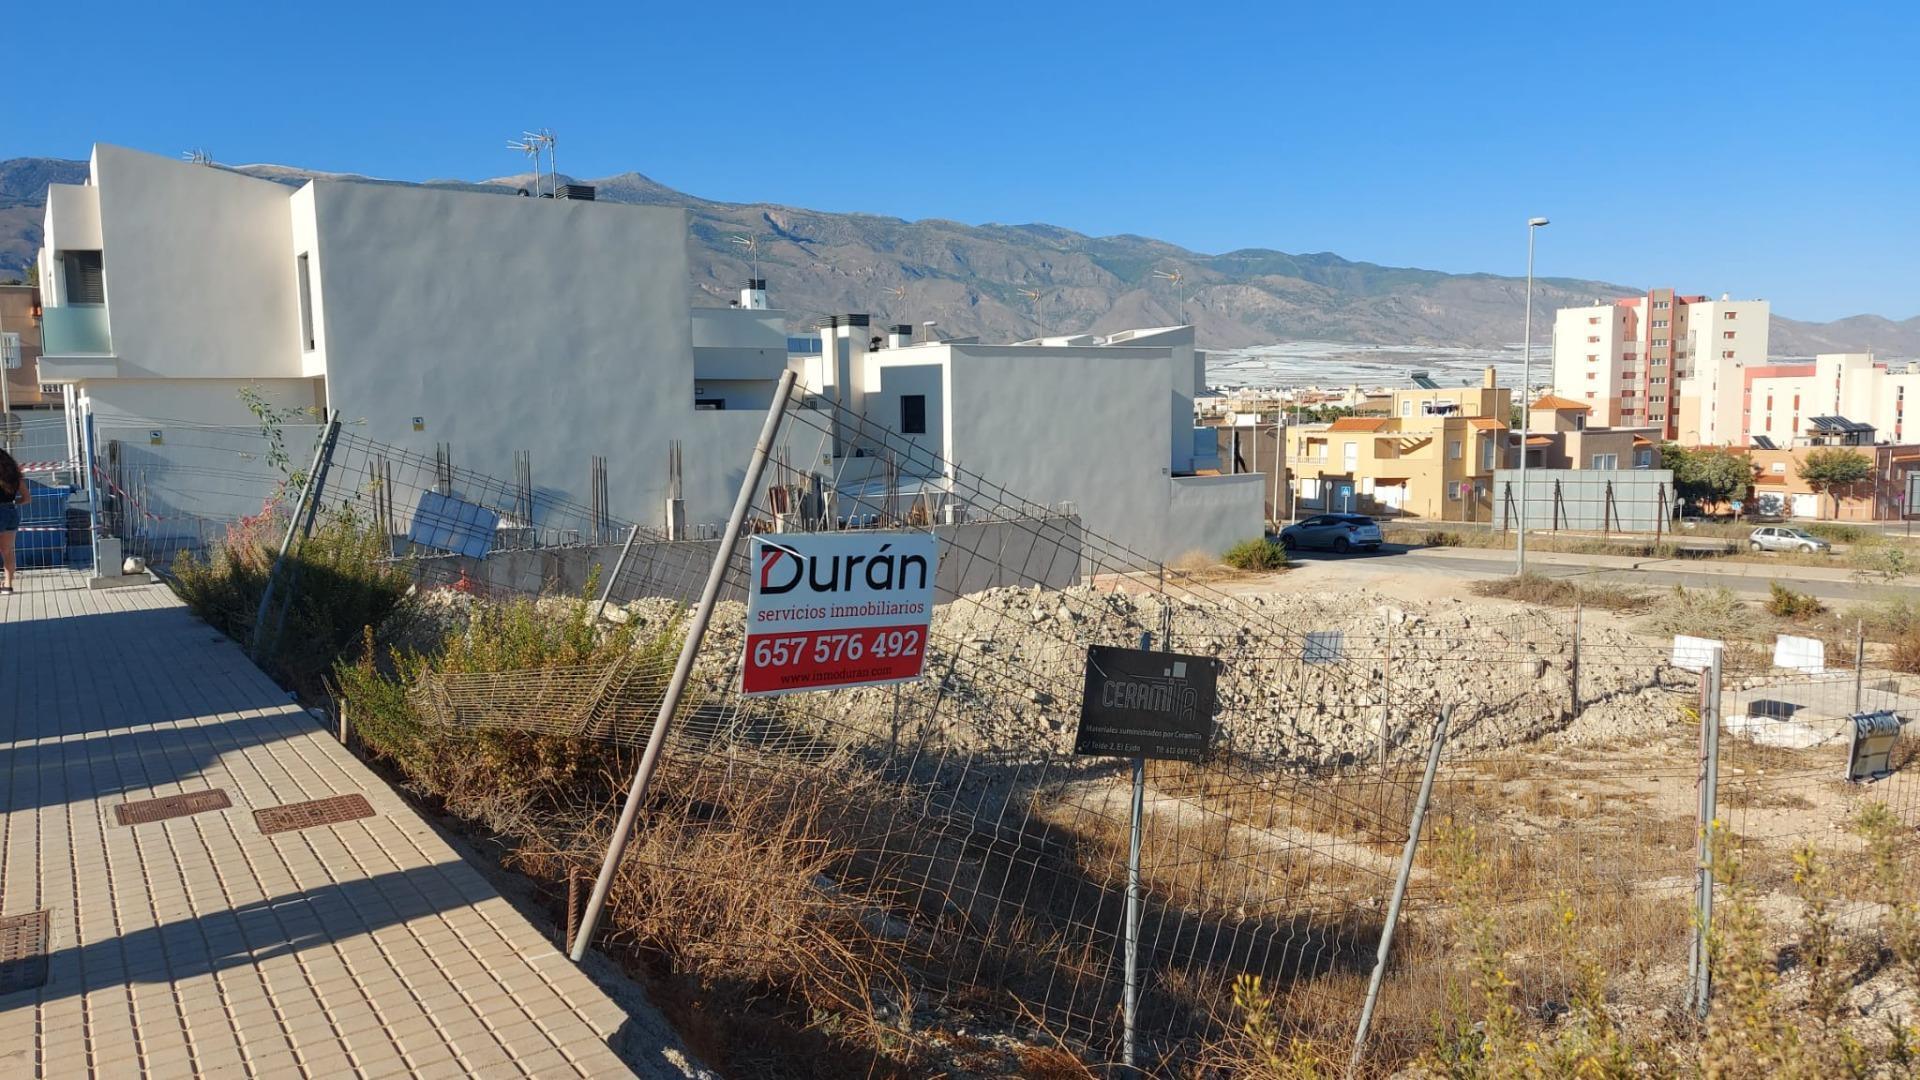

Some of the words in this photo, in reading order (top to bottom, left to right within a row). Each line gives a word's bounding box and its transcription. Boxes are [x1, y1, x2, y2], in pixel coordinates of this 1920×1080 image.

[760, 544, 927, 594] Durán
[757, 604, 826, 622] servicios
[830, 600, 924, 618] inmobiliarios
[754, 637, 808, 668] 657
[814, 633, 863, 663] 576
[871, 630, 919, 658] 492
[780, 666, 892, 684] www.inmoduran.com
